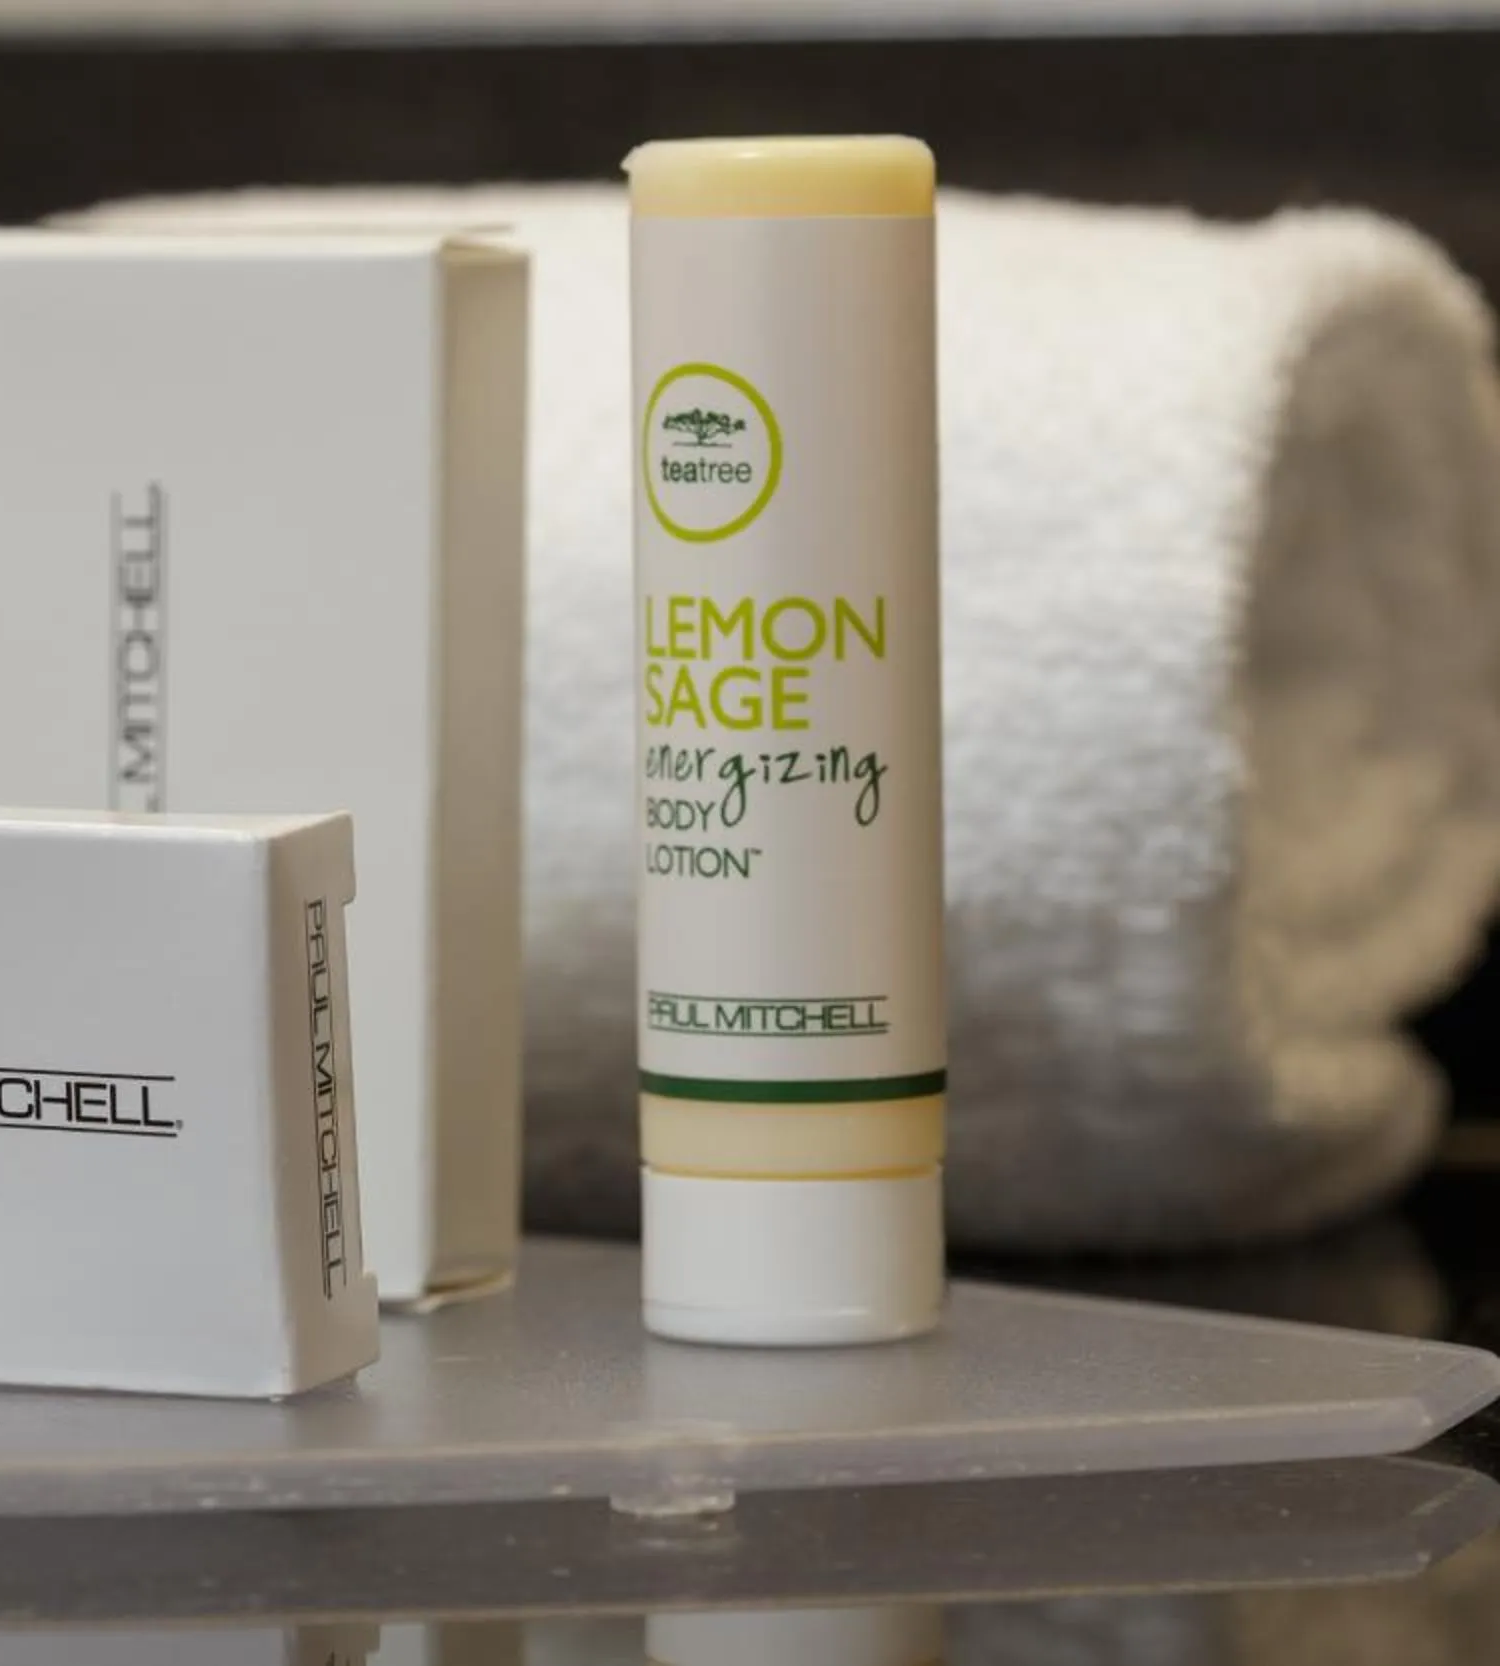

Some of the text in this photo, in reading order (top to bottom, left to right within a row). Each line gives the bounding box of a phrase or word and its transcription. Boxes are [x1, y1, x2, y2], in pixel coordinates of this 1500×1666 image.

[660, 456, 752, 483] teatree
[645, 595, 885, 660] LEMON
[646, 663, 810, 730] SAGE
[647, 745, 888, 827] energizing
[648, 797, 715, 830] BODY
[650, 997, 886, 1030] PAUL MITCHELL
[308, 899, 345, 1300] PAUL MITCHELL
